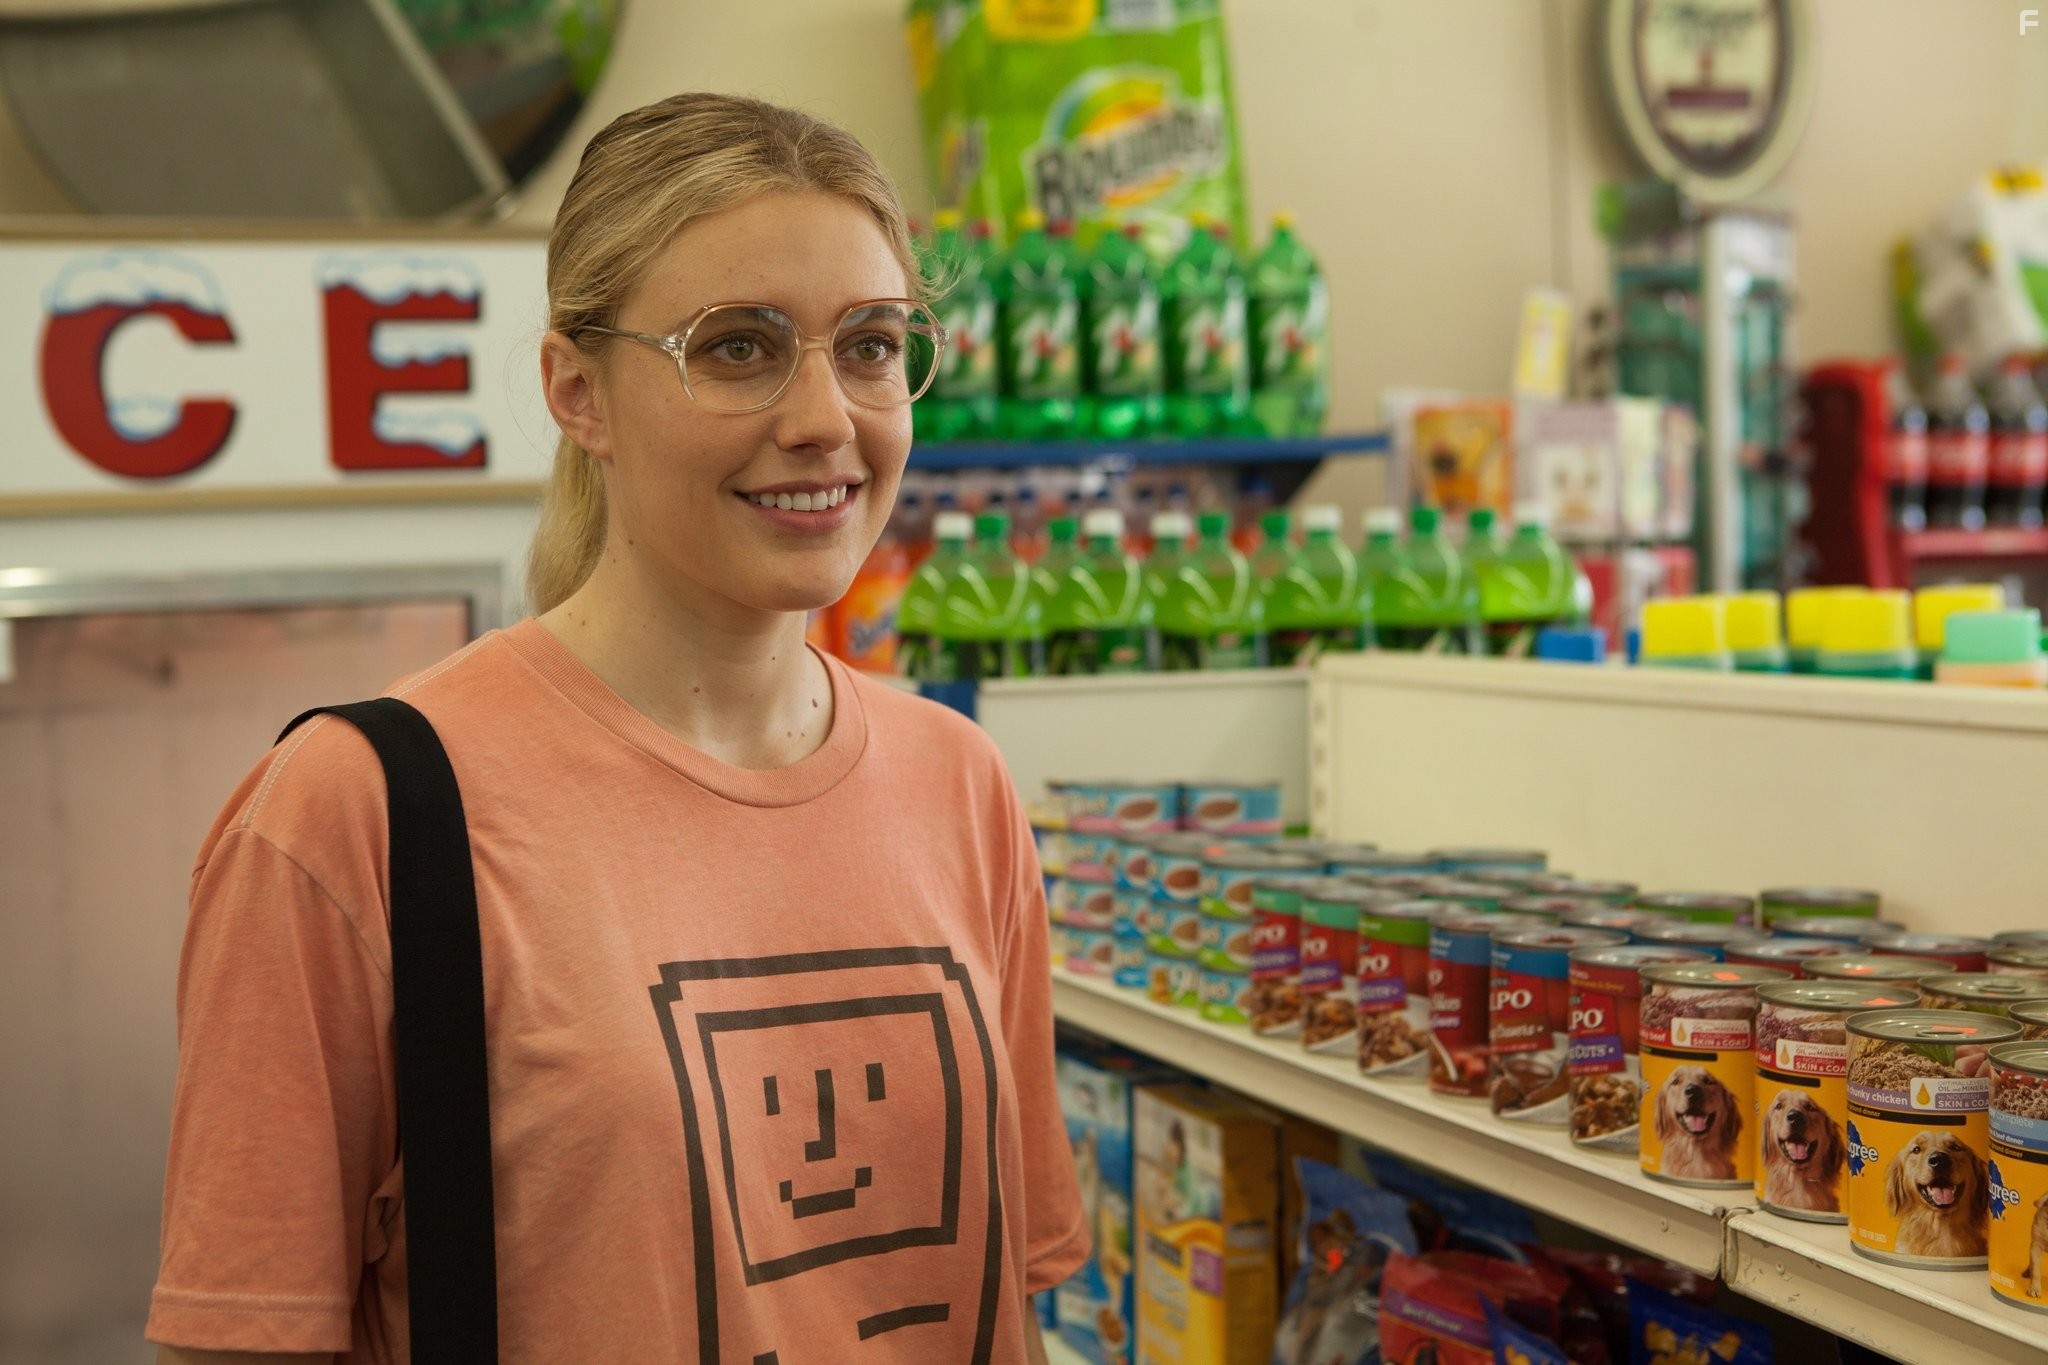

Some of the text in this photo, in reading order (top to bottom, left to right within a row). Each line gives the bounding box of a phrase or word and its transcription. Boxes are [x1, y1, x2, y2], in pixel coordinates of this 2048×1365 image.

[1795, 1062, 1818, 1071] SKIN
[1872, 1093, 1908, 1105] chicken
[1938, 1100, 1962, 1108] SKIN
[1996, 1111, 2034, 1129] complete
[2006, 1135, 2025, 1146] dinner
